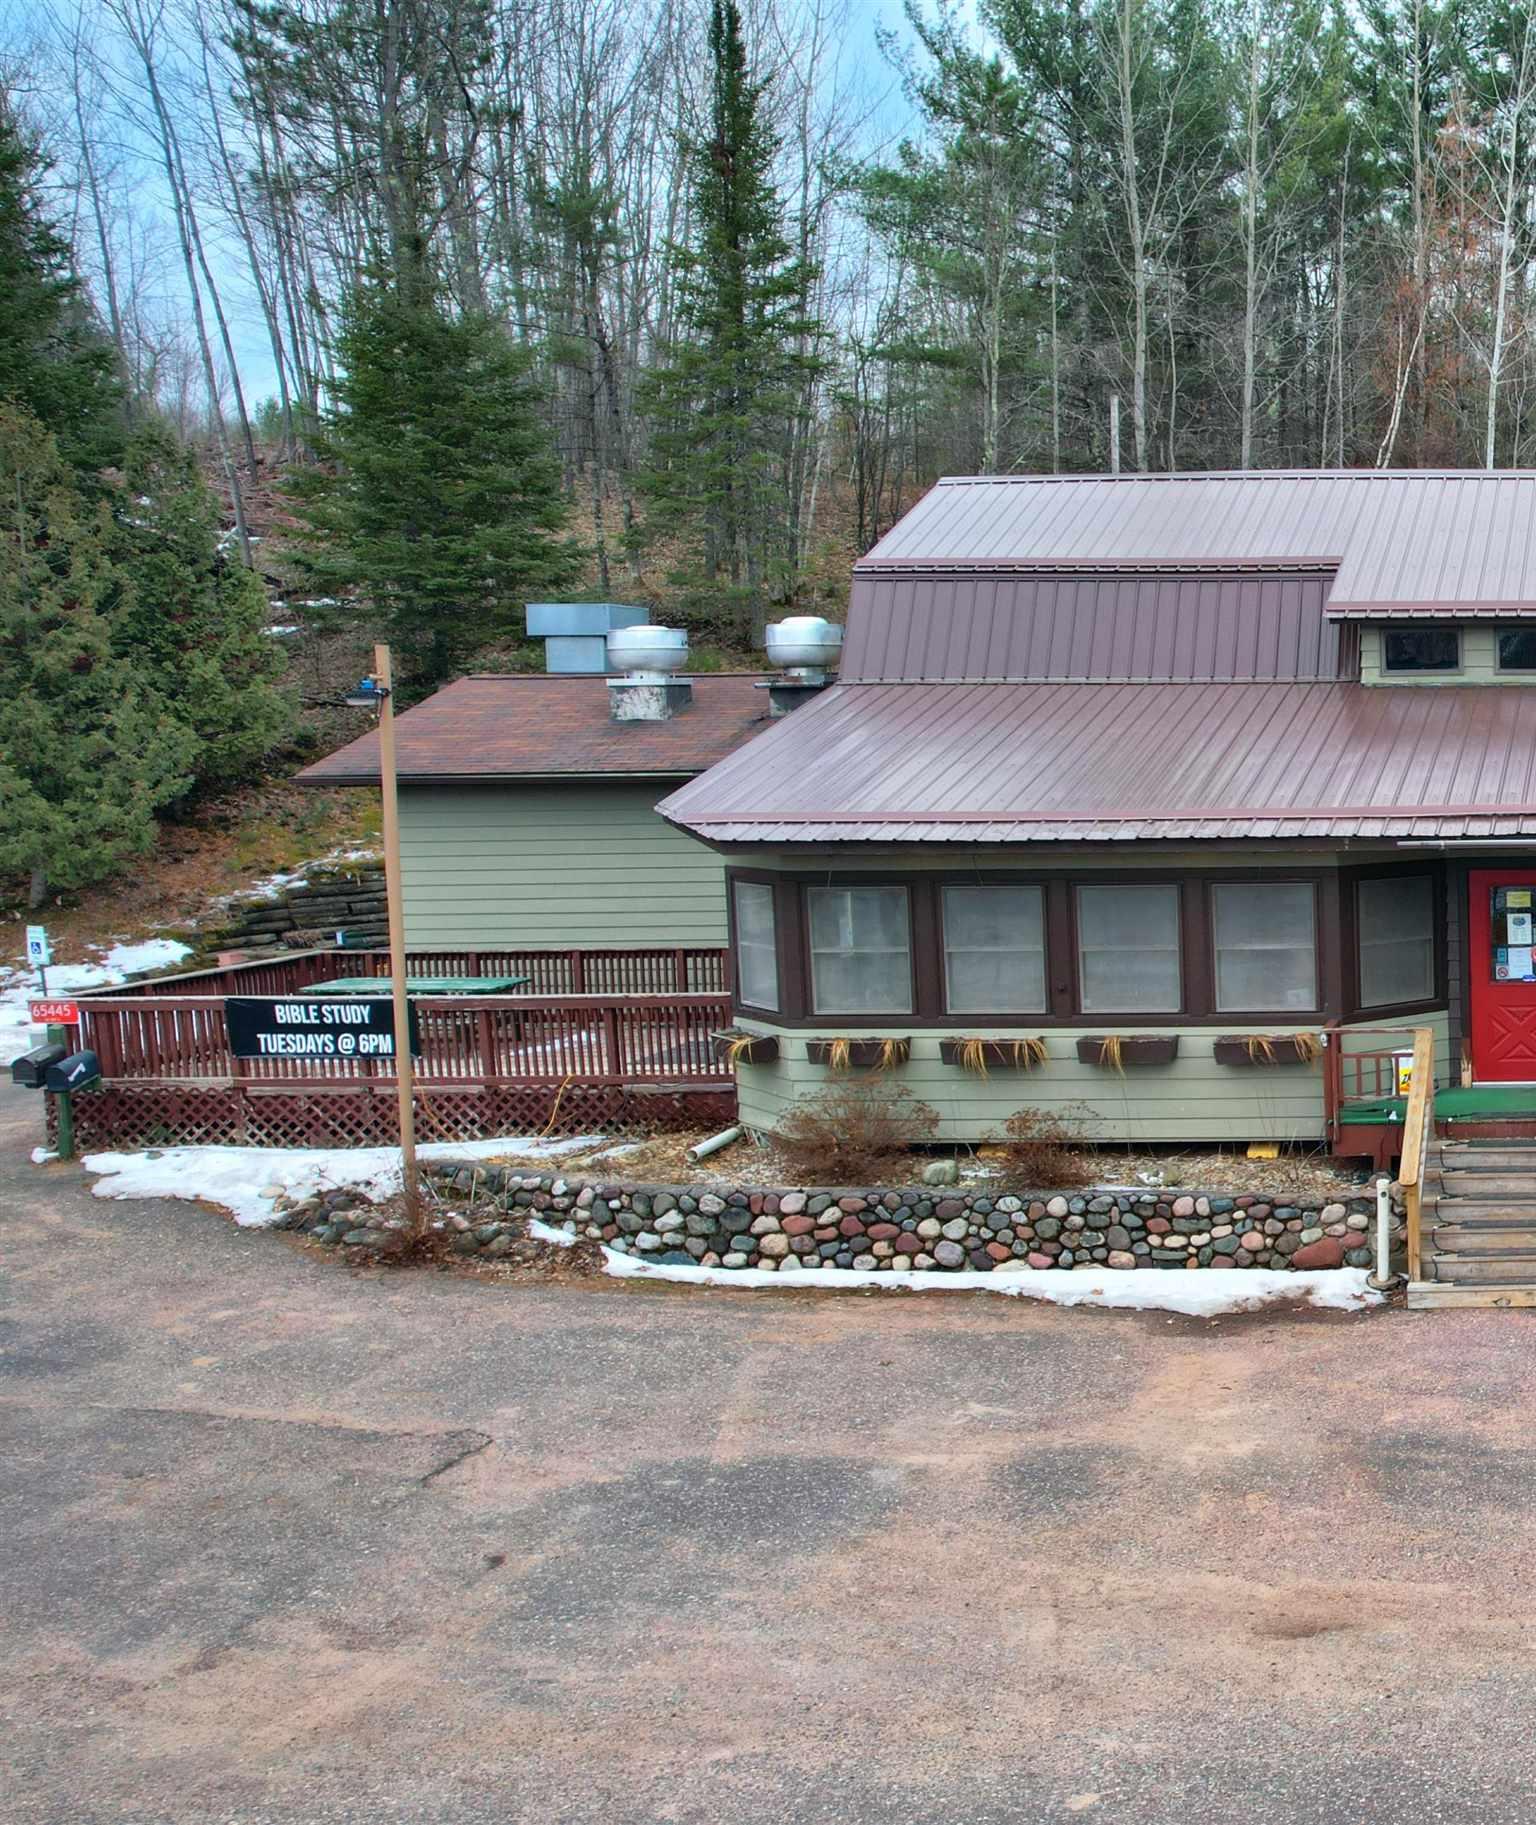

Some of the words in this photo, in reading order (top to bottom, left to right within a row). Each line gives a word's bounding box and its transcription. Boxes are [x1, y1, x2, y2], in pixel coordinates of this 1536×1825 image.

[32, 1004, 71, 1017] 65445
[275, 1004, 320, 1024] BIBLE
[322, 1004, 371, 1024] STUDY
[256, 1033, 334, 1054] TUESDAYS
[337, 1033, 355, 1054] @
[359, 1033, 392, 1054] 6PM
